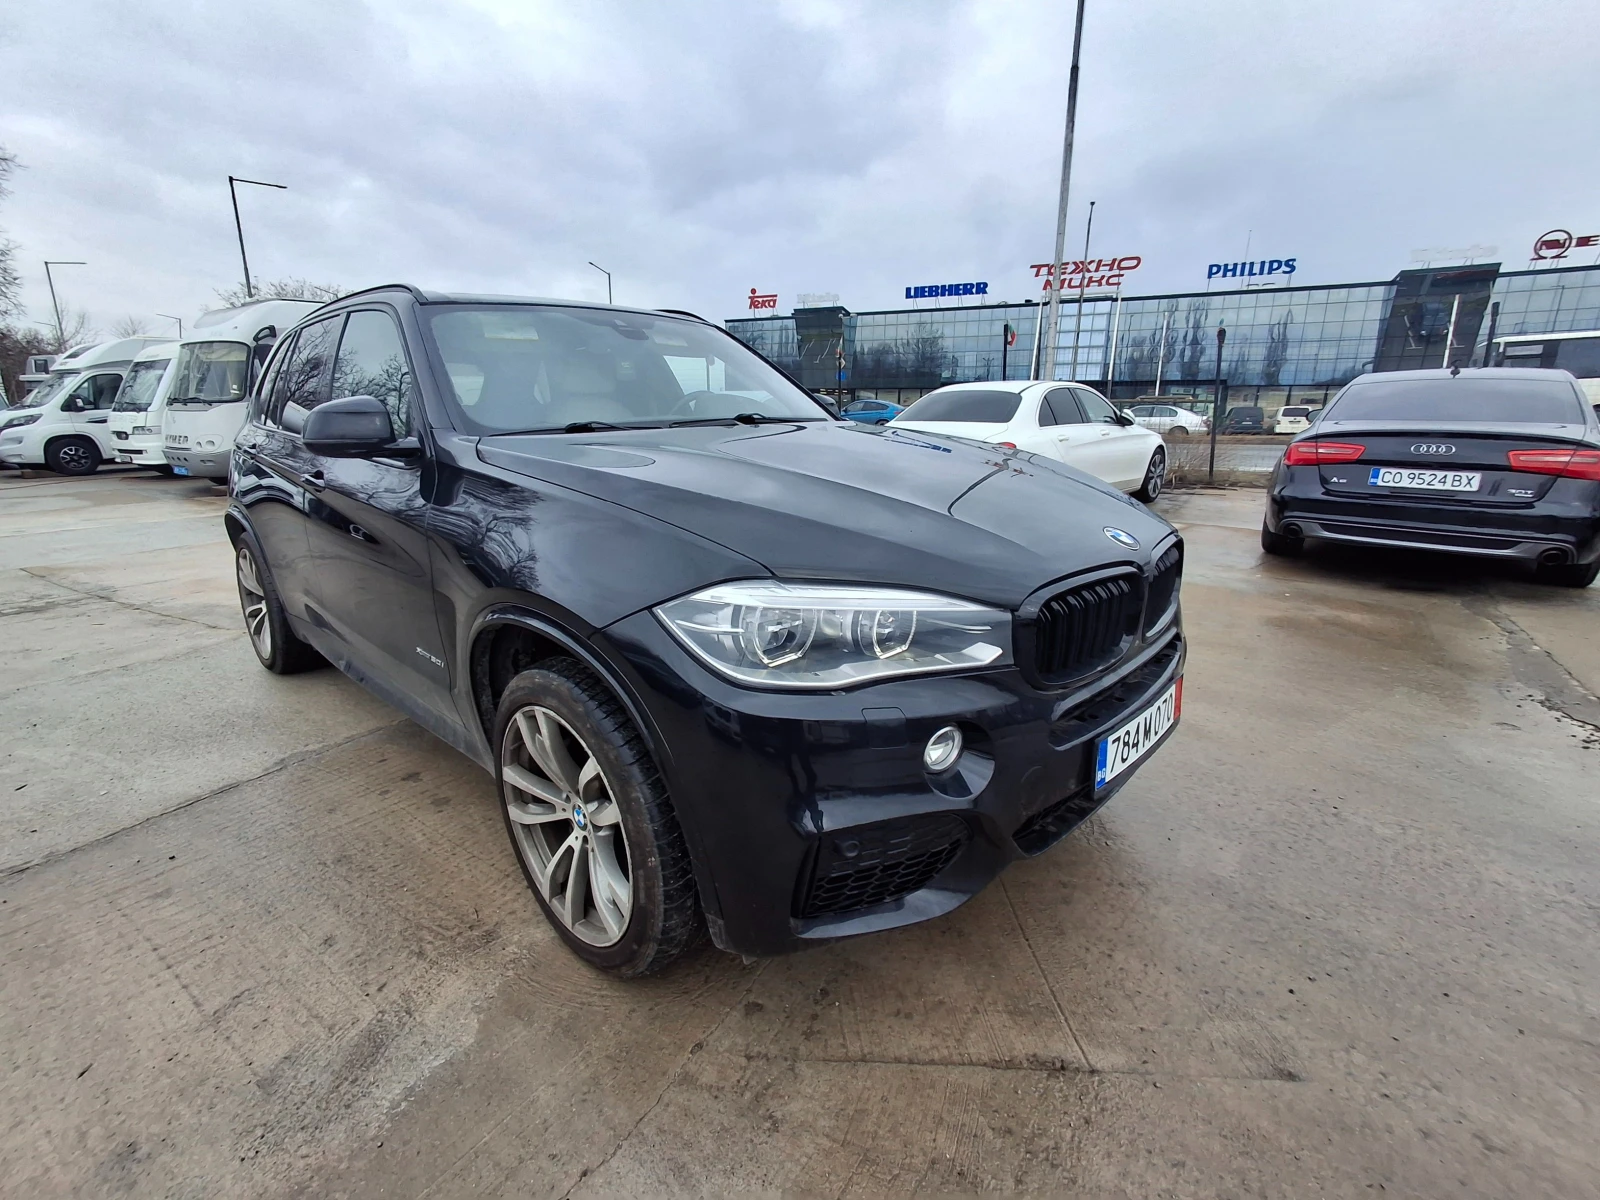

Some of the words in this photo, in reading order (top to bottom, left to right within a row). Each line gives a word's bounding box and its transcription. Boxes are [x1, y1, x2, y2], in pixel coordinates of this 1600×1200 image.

[1207, 258, 1297, 279] PHILIPS
[905, 282, 989, 299] LIEBHERR
[1407, 472, 1448, 487] 9524
[1451, 474, 1476, 488] BX
